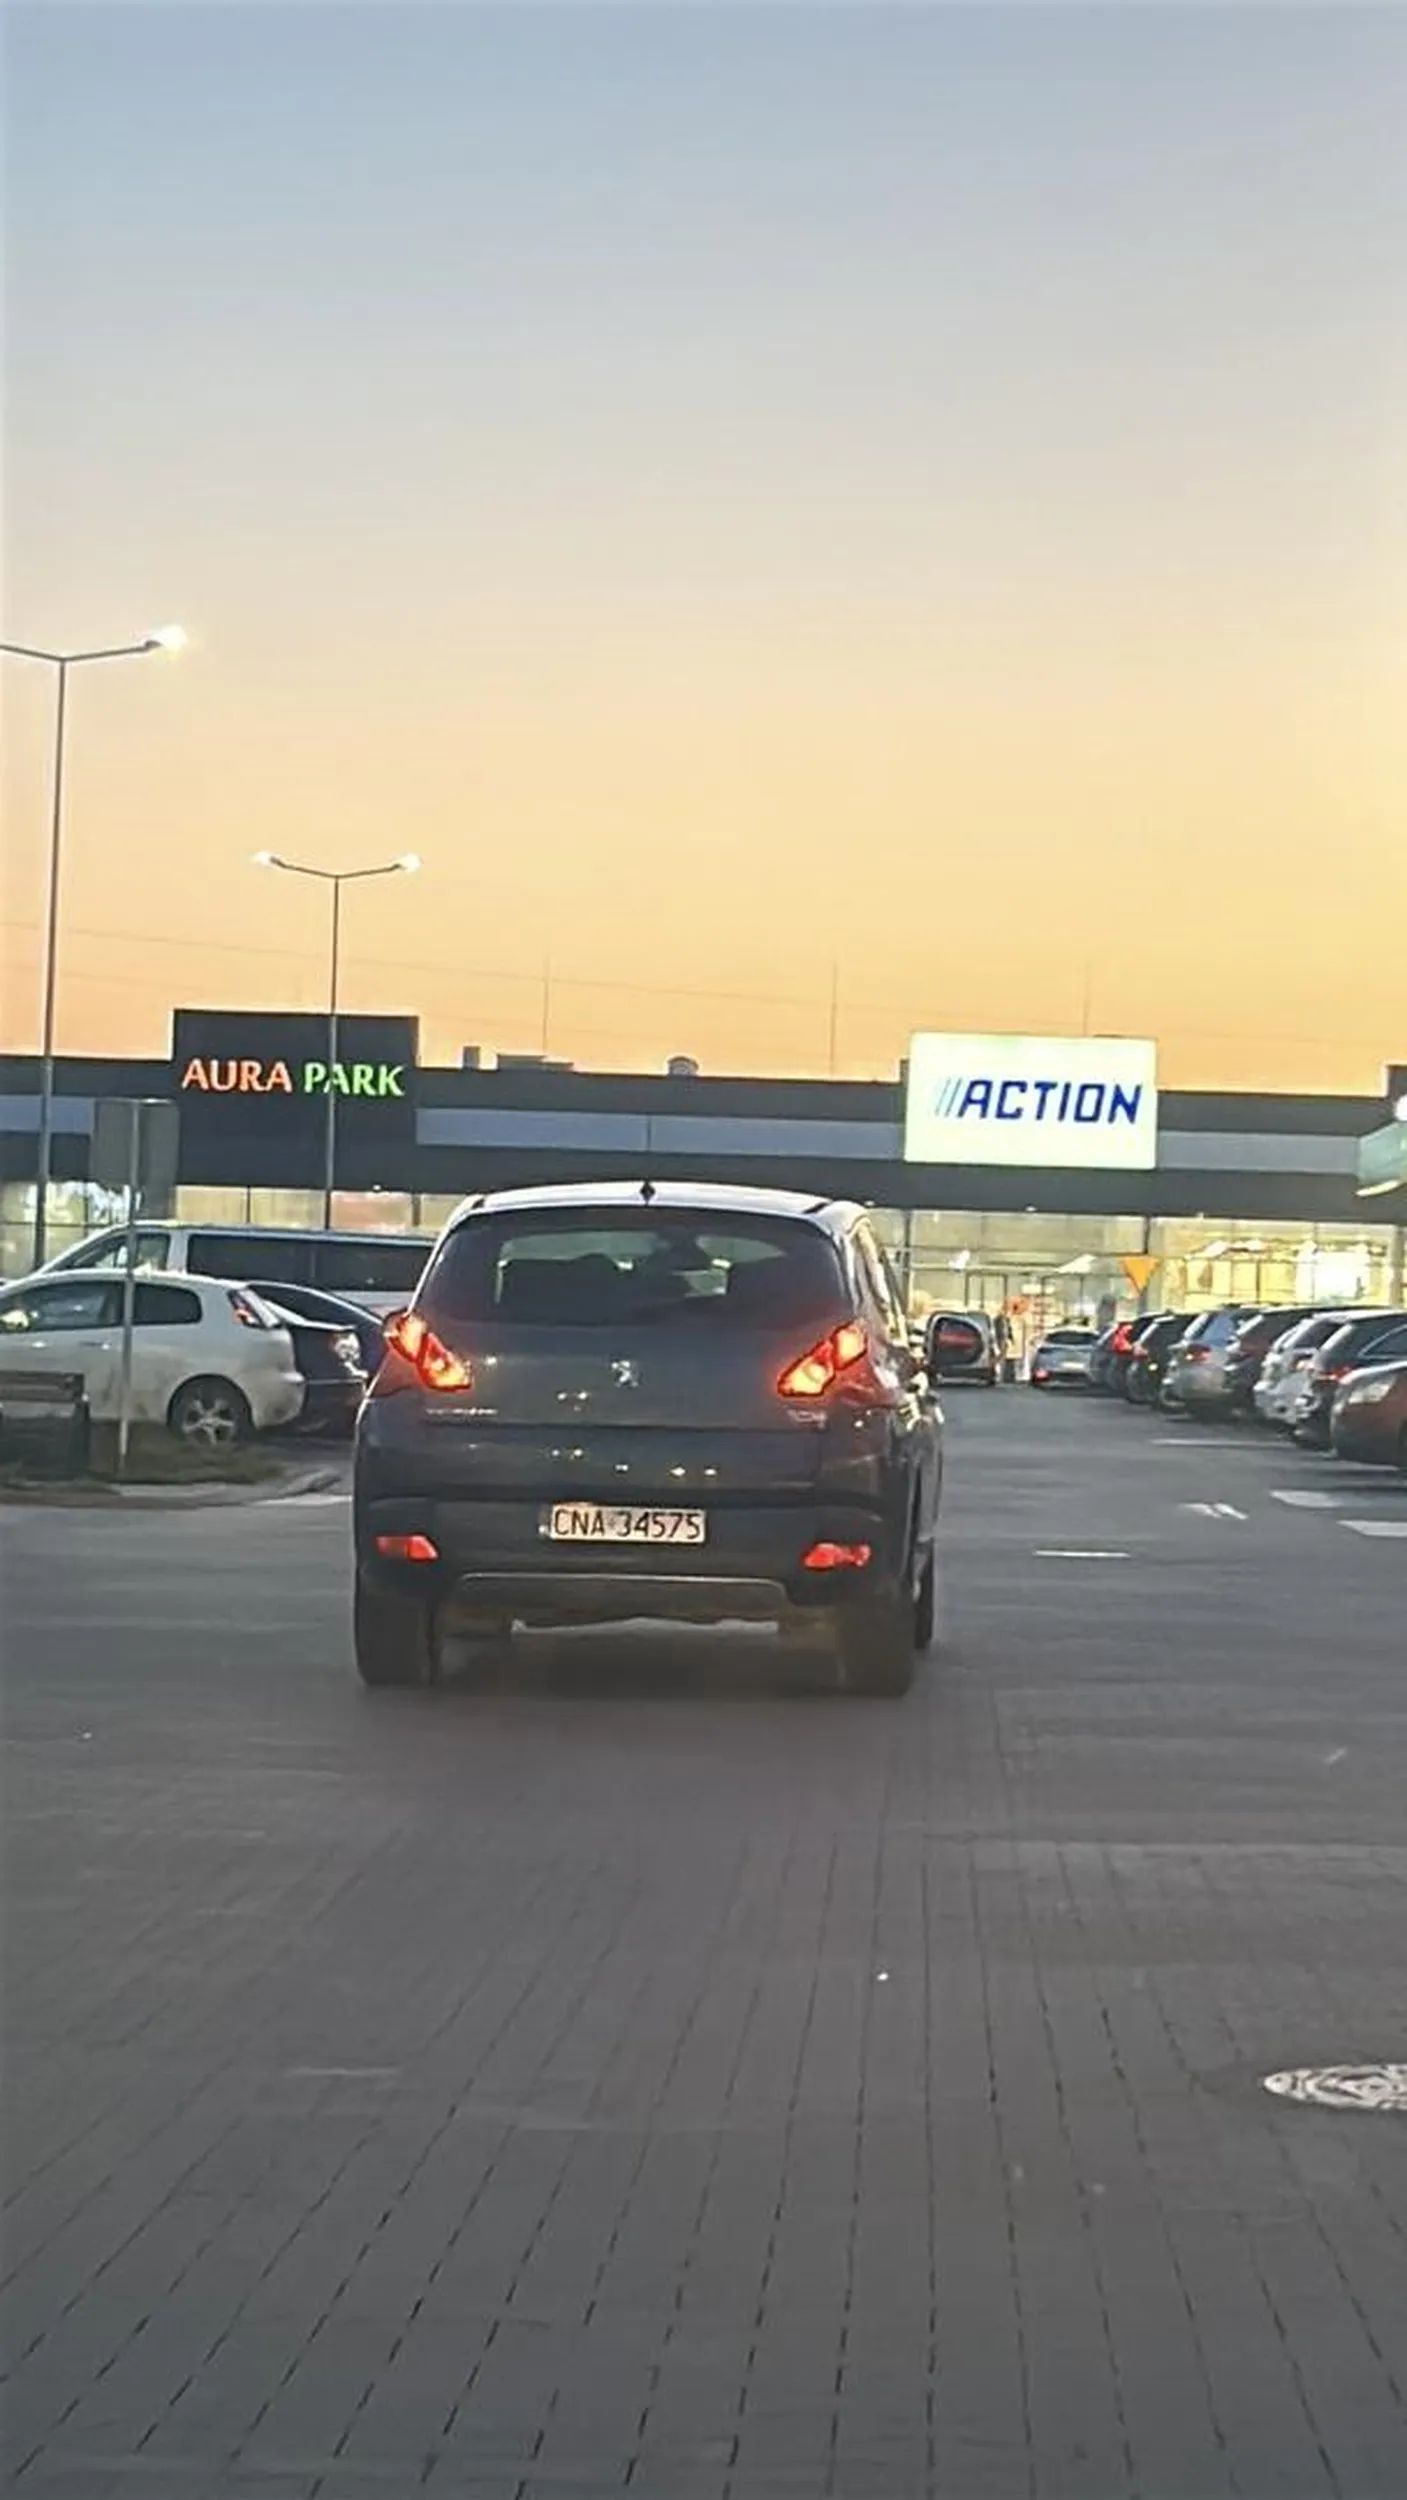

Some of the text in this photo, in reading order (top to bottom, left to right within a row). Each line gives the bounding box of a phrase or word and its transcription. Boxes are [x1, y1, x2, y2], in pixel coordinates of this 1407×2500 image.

[182, 1058, 405, 1096] AURA PARK
[957, 1079, 1143, 1124] ACTION
[554, 1509, 701, 1540] CNA 34575
